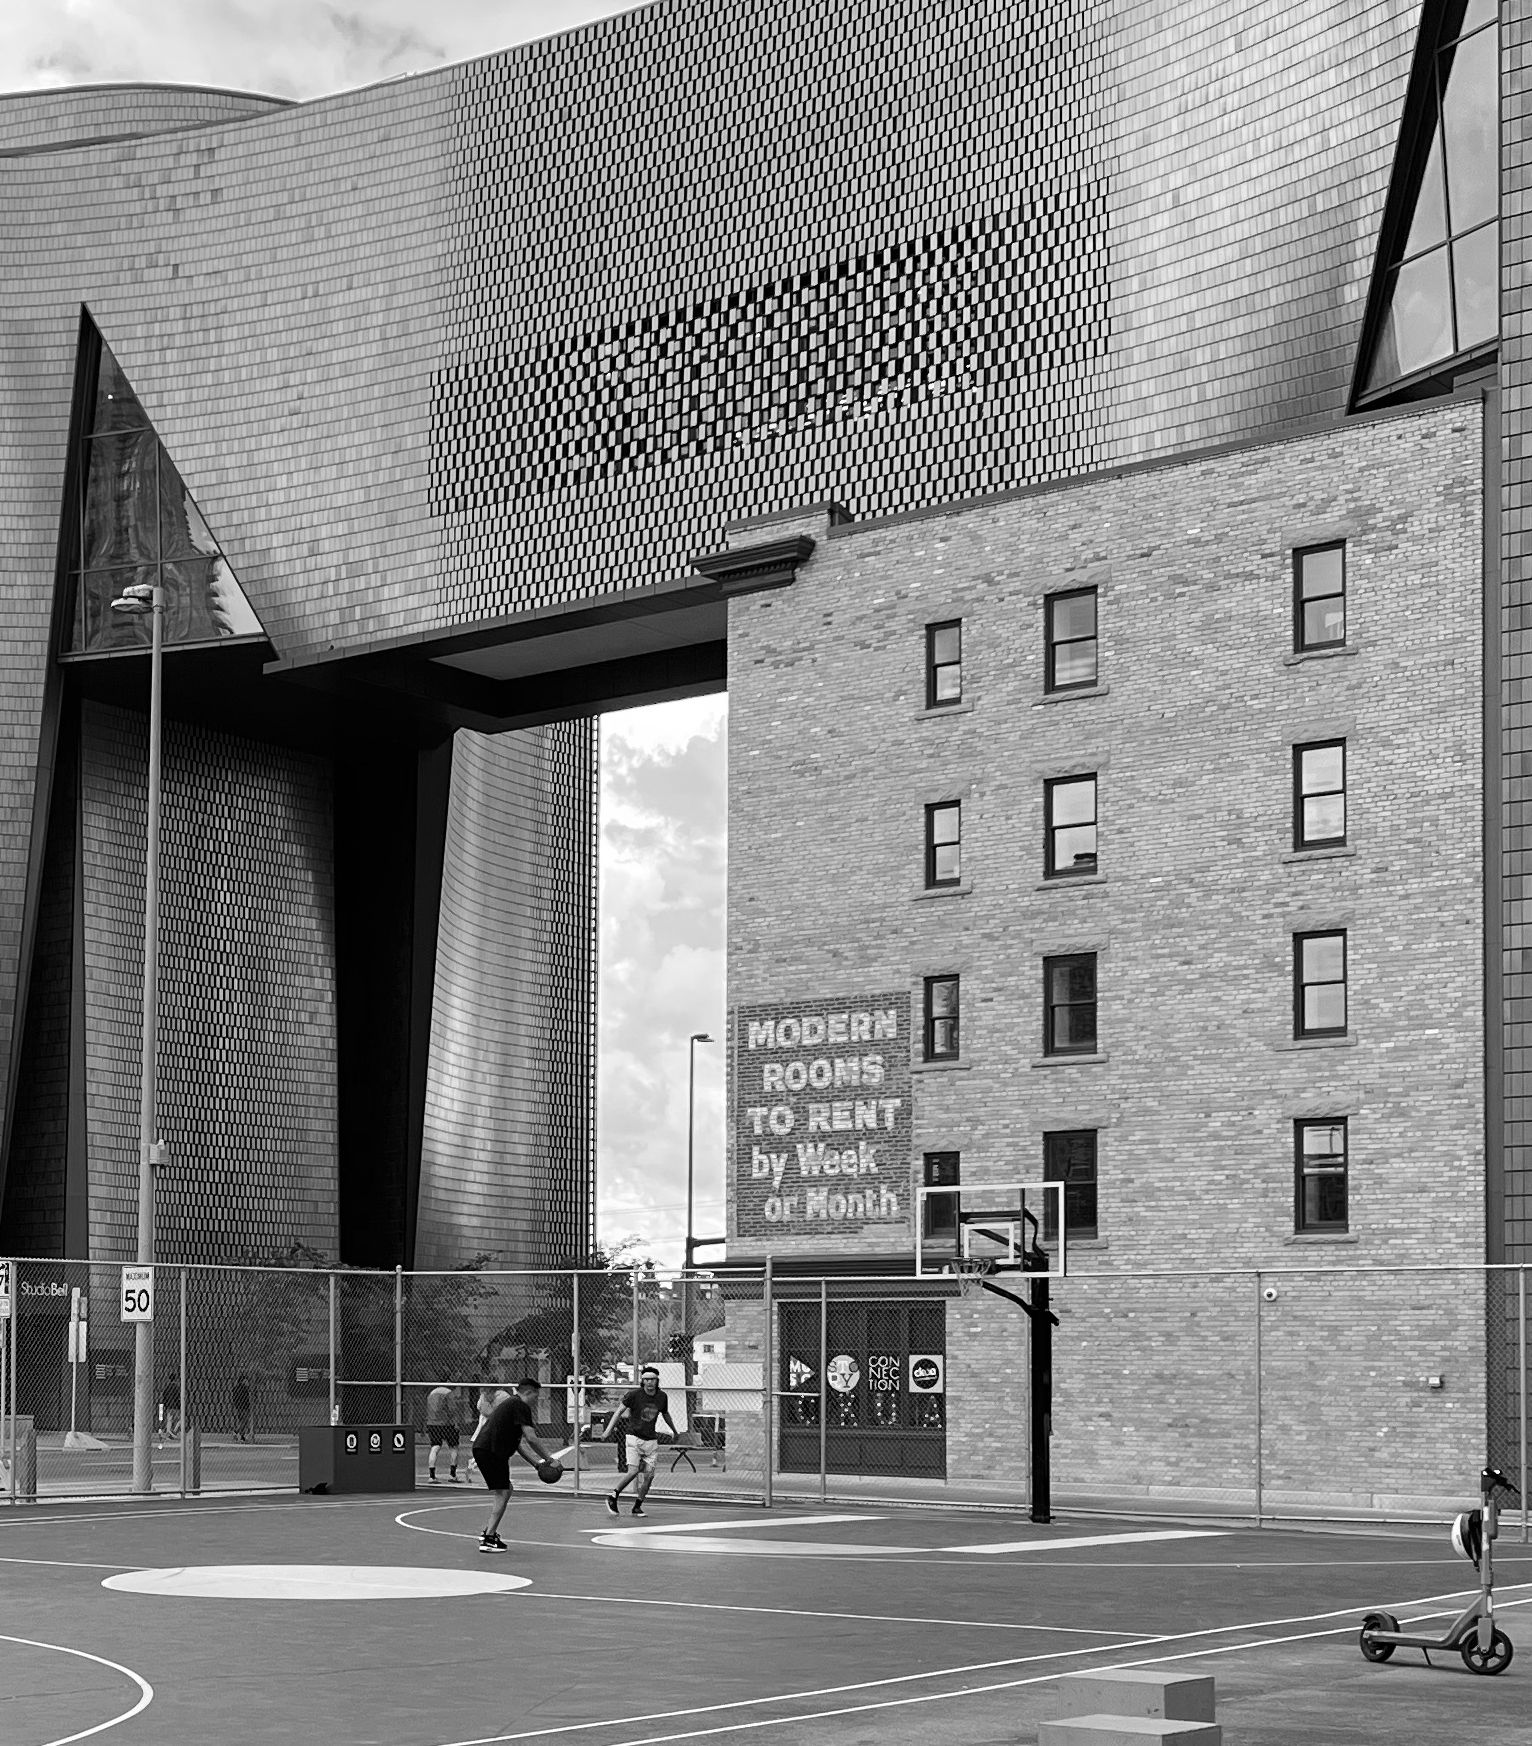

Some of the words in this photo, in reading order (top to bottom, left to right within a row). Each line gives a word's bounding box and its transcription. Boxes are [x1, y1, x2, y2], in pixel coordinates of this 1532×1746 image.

[747, 1009, 898, 1050] MODERN
[762, 1053, 886, 1093] ROOMS
[747, 1105, 796, 1136] TO
[808, 1098, 902, 1132] RENT
[751, 1145, 789, 1189] by
[796, 1141, 879, 1177] Week
[764, 1195, 798, 1222] or
[806, 1184, 901, 1221] Month
[124, 1289, 150, 1312] 50
